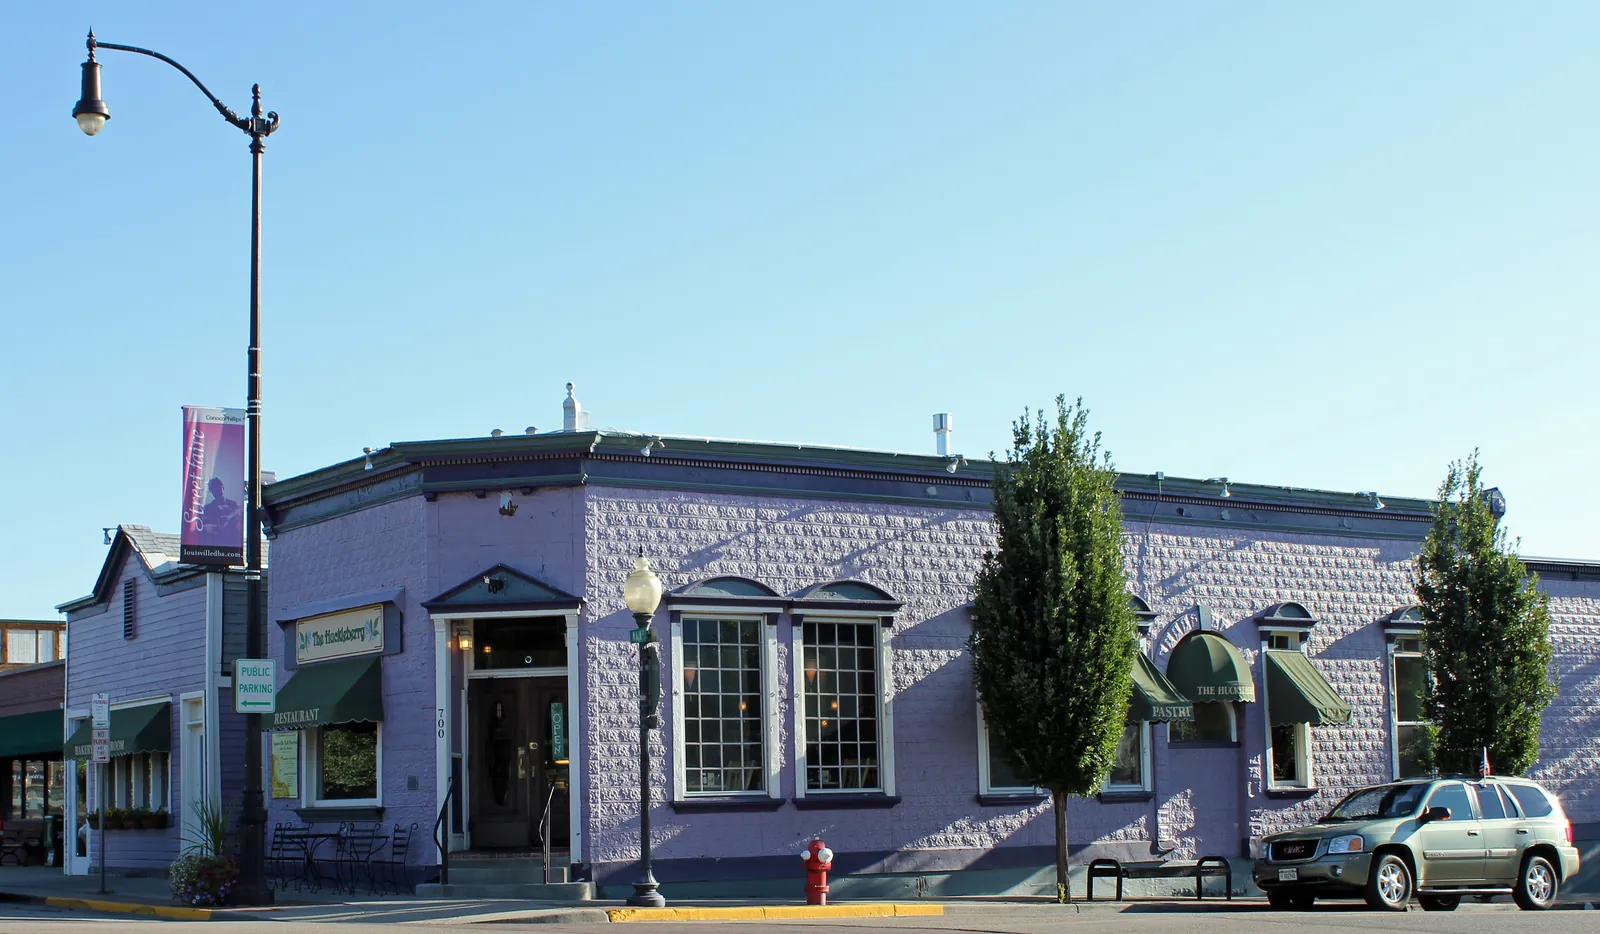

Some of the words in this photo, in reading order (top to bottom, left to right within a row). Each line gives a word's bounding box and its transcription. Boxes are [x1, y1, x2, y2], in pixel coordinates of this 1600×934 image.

[312, 630, 324, 647] The
[325, 626, 365, 645] Huckleberry
[241, 666, 270, 677] PUBLIC
[239, 683, 273, 694] PARKING
[1197, 686, 1215, 695] THE
[274, 708, 319, 724] RESTAURANT
[1152, 706, 1193, 718] PASTRY
[552, 713, 562, 754] OPEN
